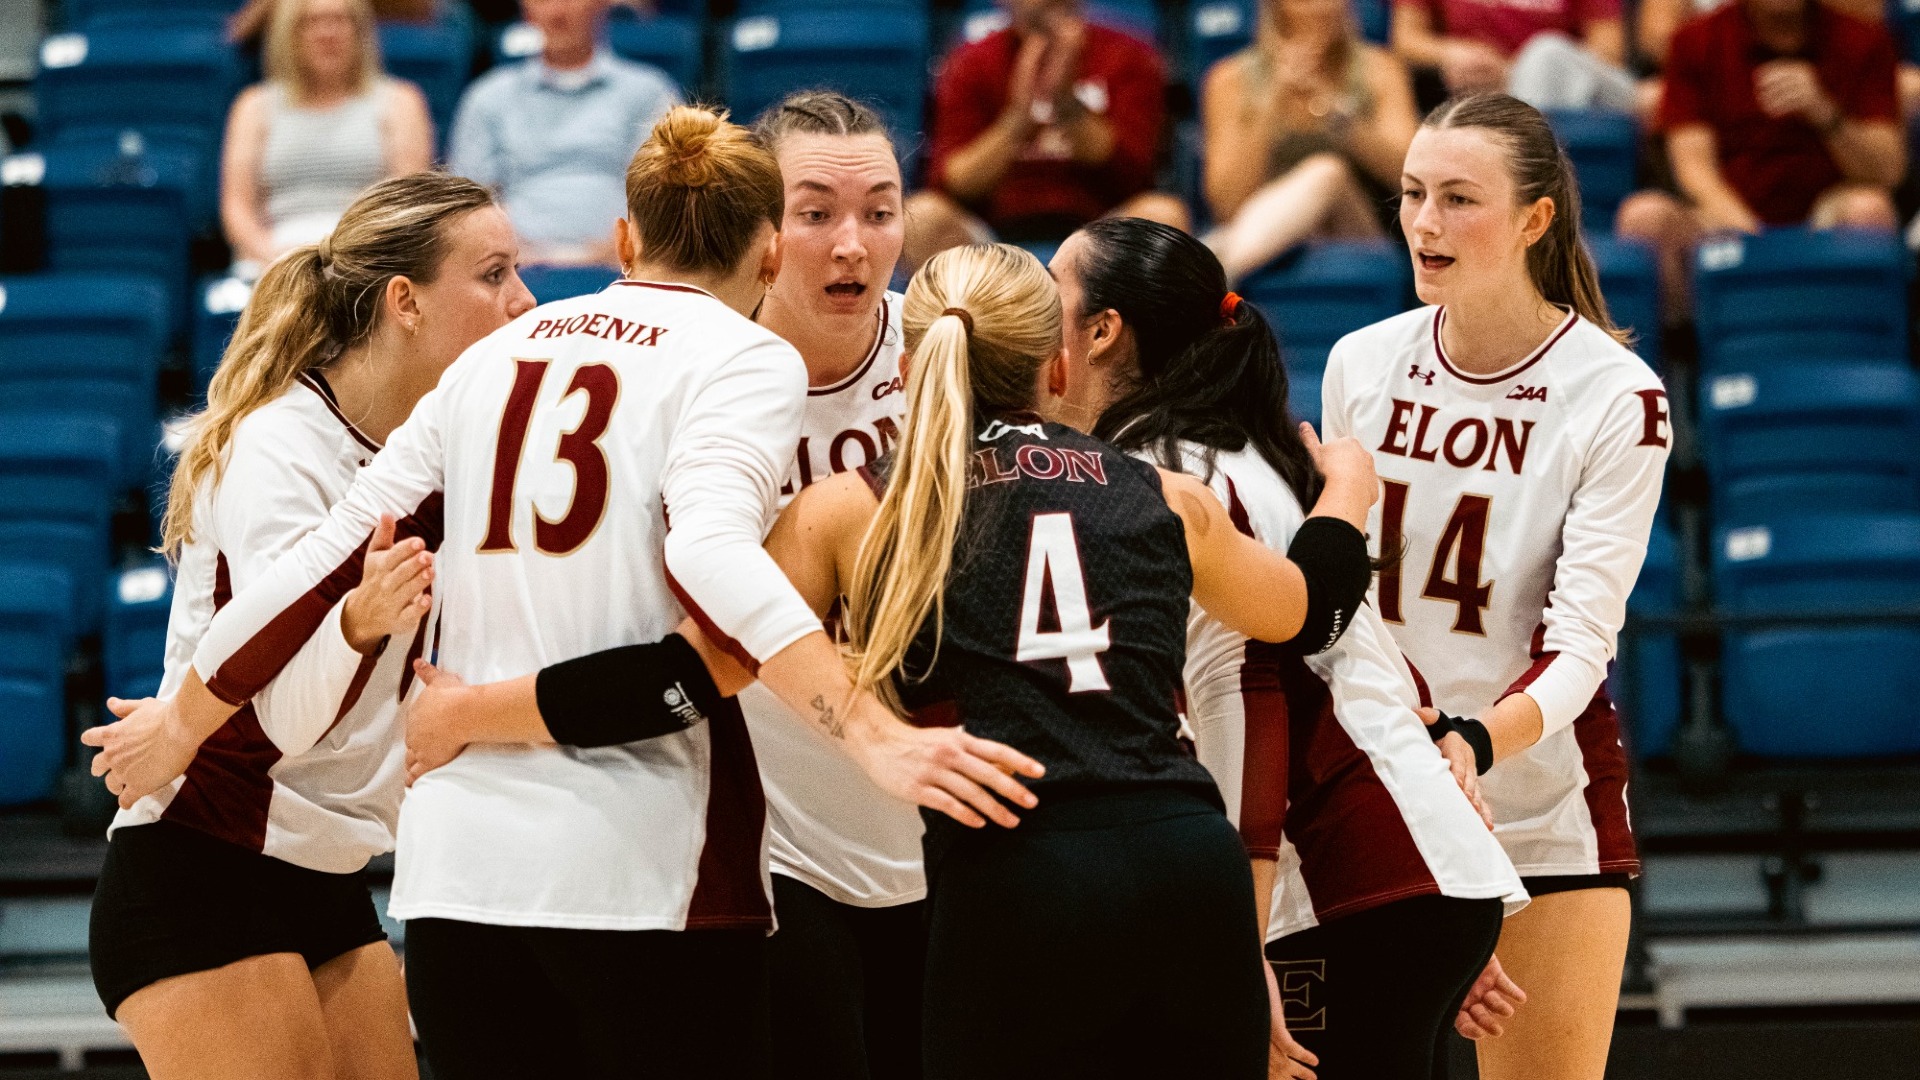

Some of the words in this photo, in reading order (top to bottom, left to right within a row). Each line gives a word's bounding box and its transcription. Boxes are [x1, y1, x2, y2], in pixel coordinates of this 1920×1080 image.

[527, 313, 669, 347] PHOENIX
[872, 376, 904, 401] CA
[1506, 384, 1548, 403] CAA
[475, 357, 622, 558] 13
[1377, 397, 1536, 476] ELON
[1376, 475, 1496, 638] 14
[1016, 512, 1112, 693] 4
[1268, 958, 1326, 1031] E
